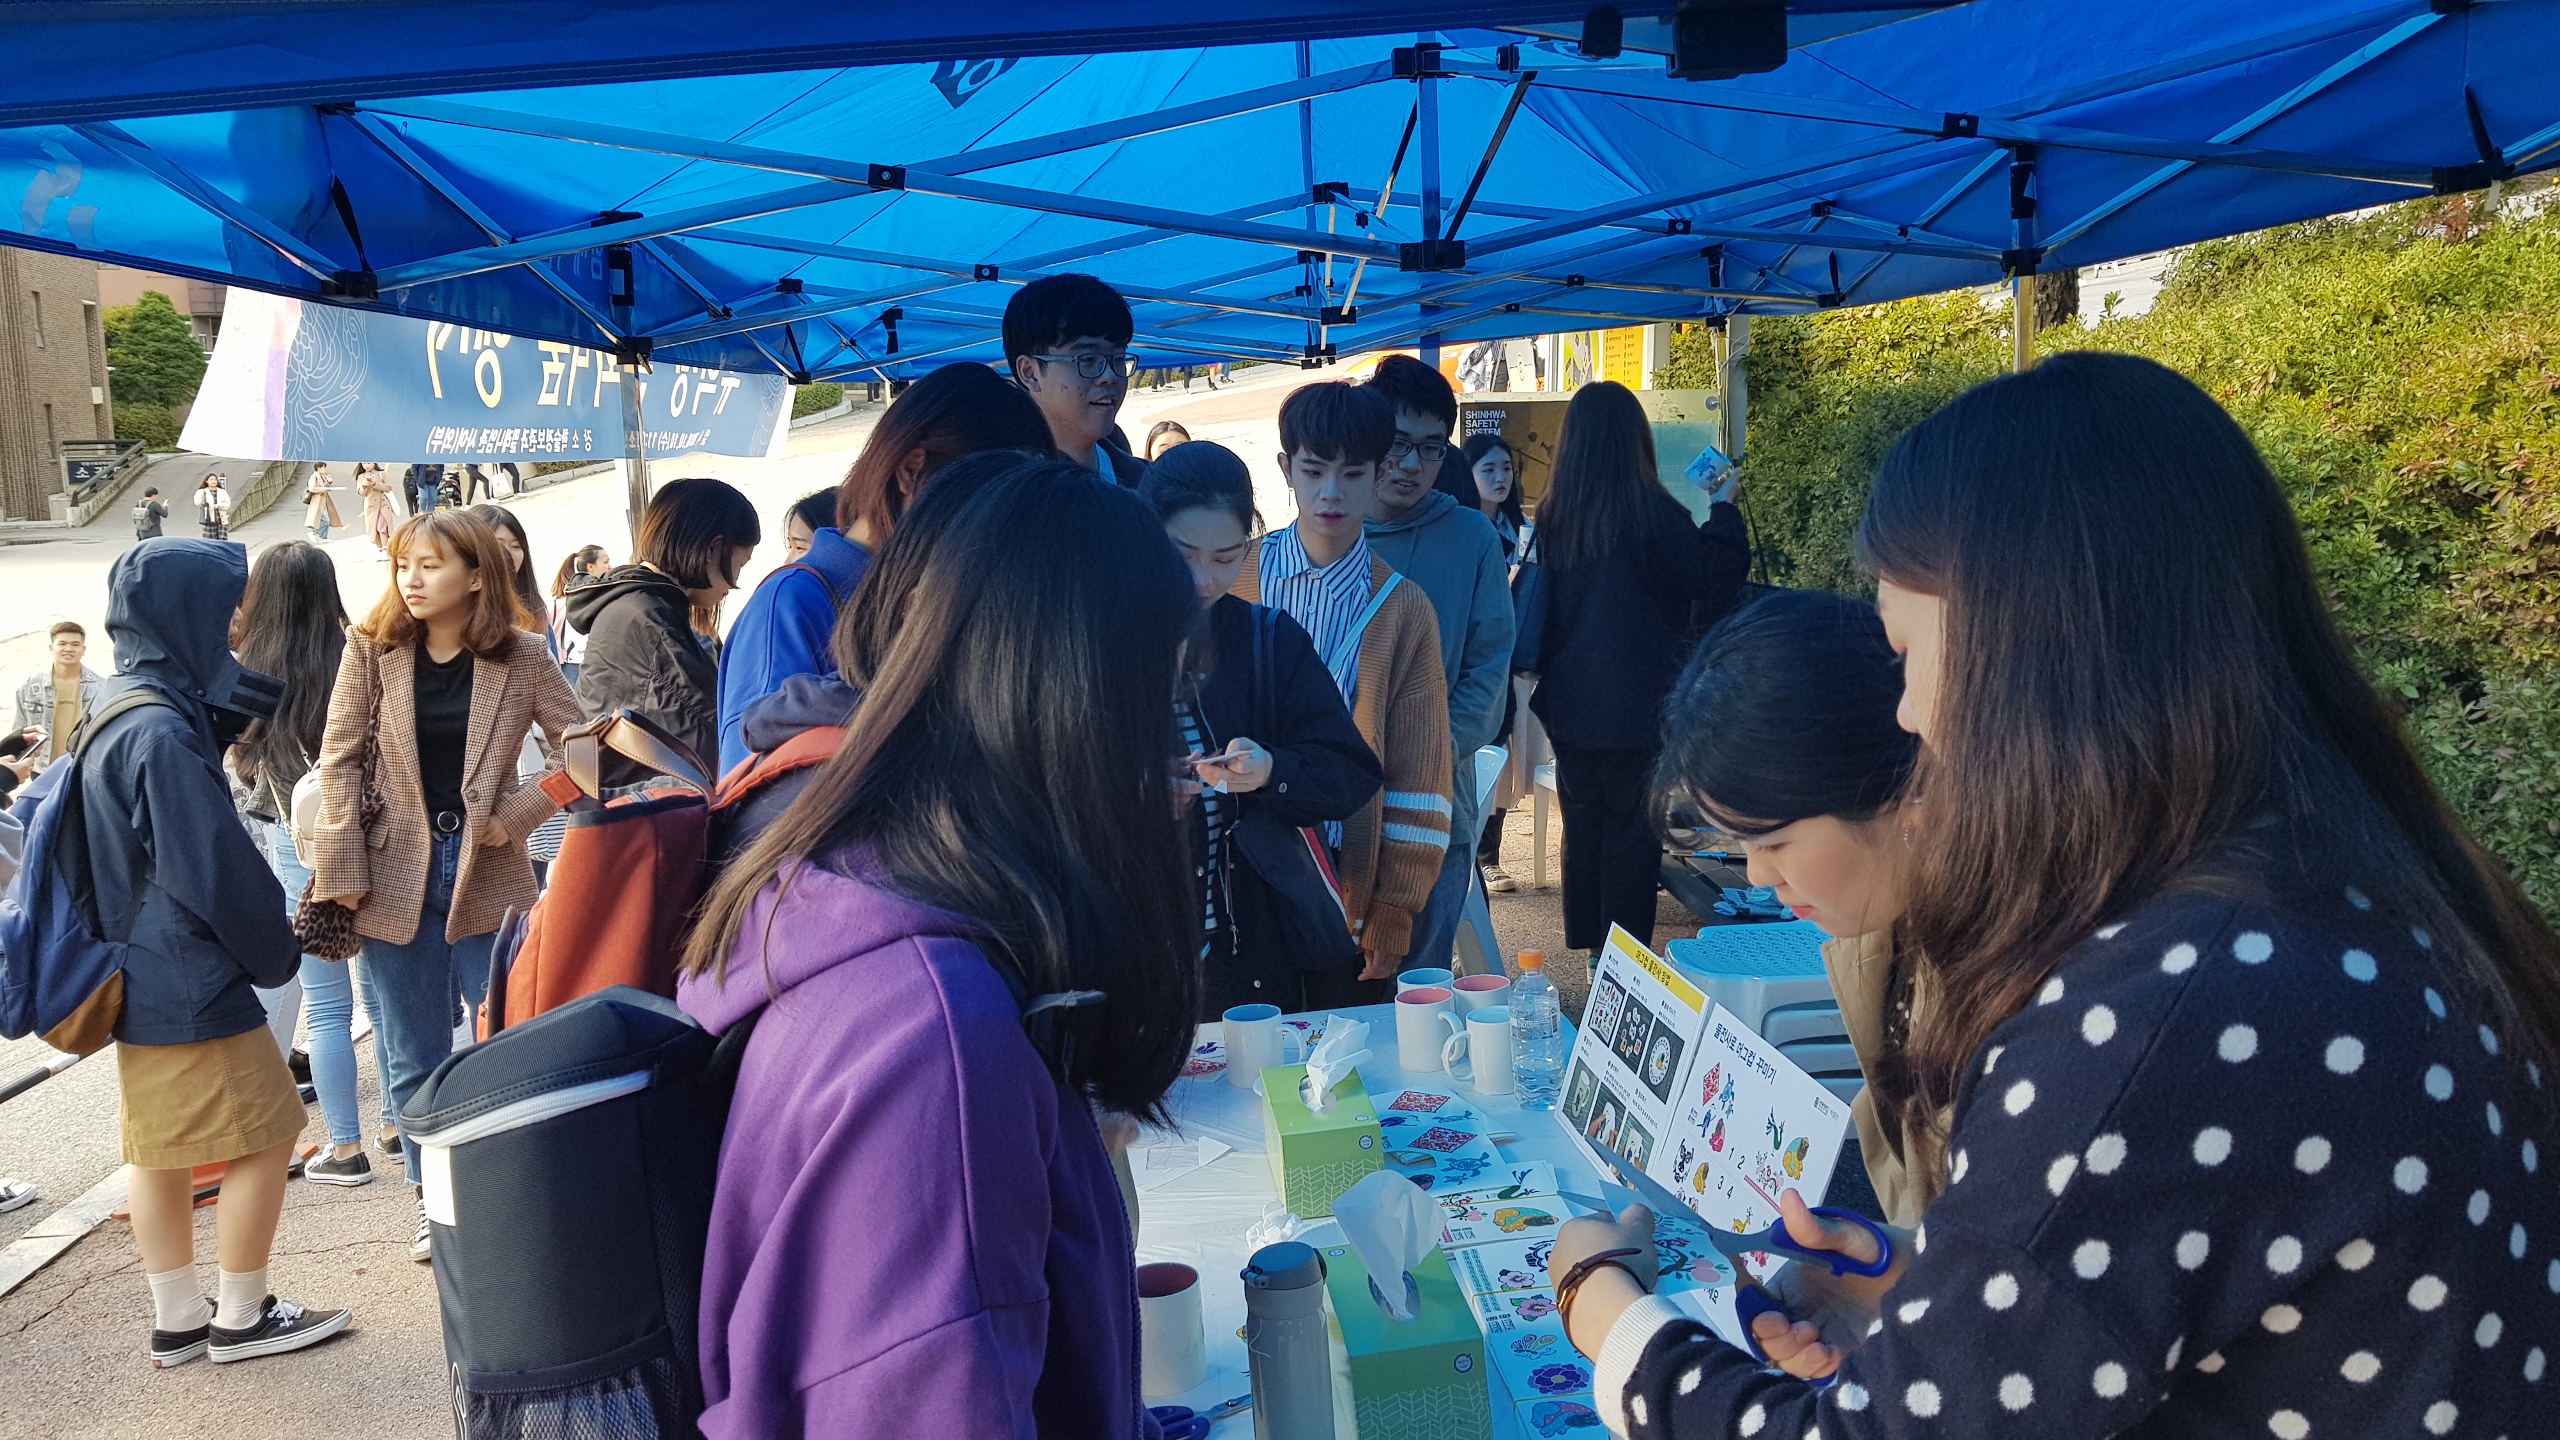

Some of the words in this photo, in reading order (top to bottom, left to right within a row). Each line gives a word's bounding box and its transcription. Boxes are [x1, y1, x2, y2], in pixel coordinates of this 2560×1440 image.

[1465, 410, 1507, 420] SHINHWA
[1465, 419, 1500, 428] SAFETY
[1713, 1022, 1738, 1052] 물전사로
[1735, 1042, 1757, 1069] 머그컵
[1755, 1056, 1778, 1086] 꾸미기
[1728, 1146, 1735, 1161] 1
[1737, 1155, 1746, 1170] 2
[1717, 1175, 1725, 1190] 3
[1726, 1185, 1734, 1200] 4
